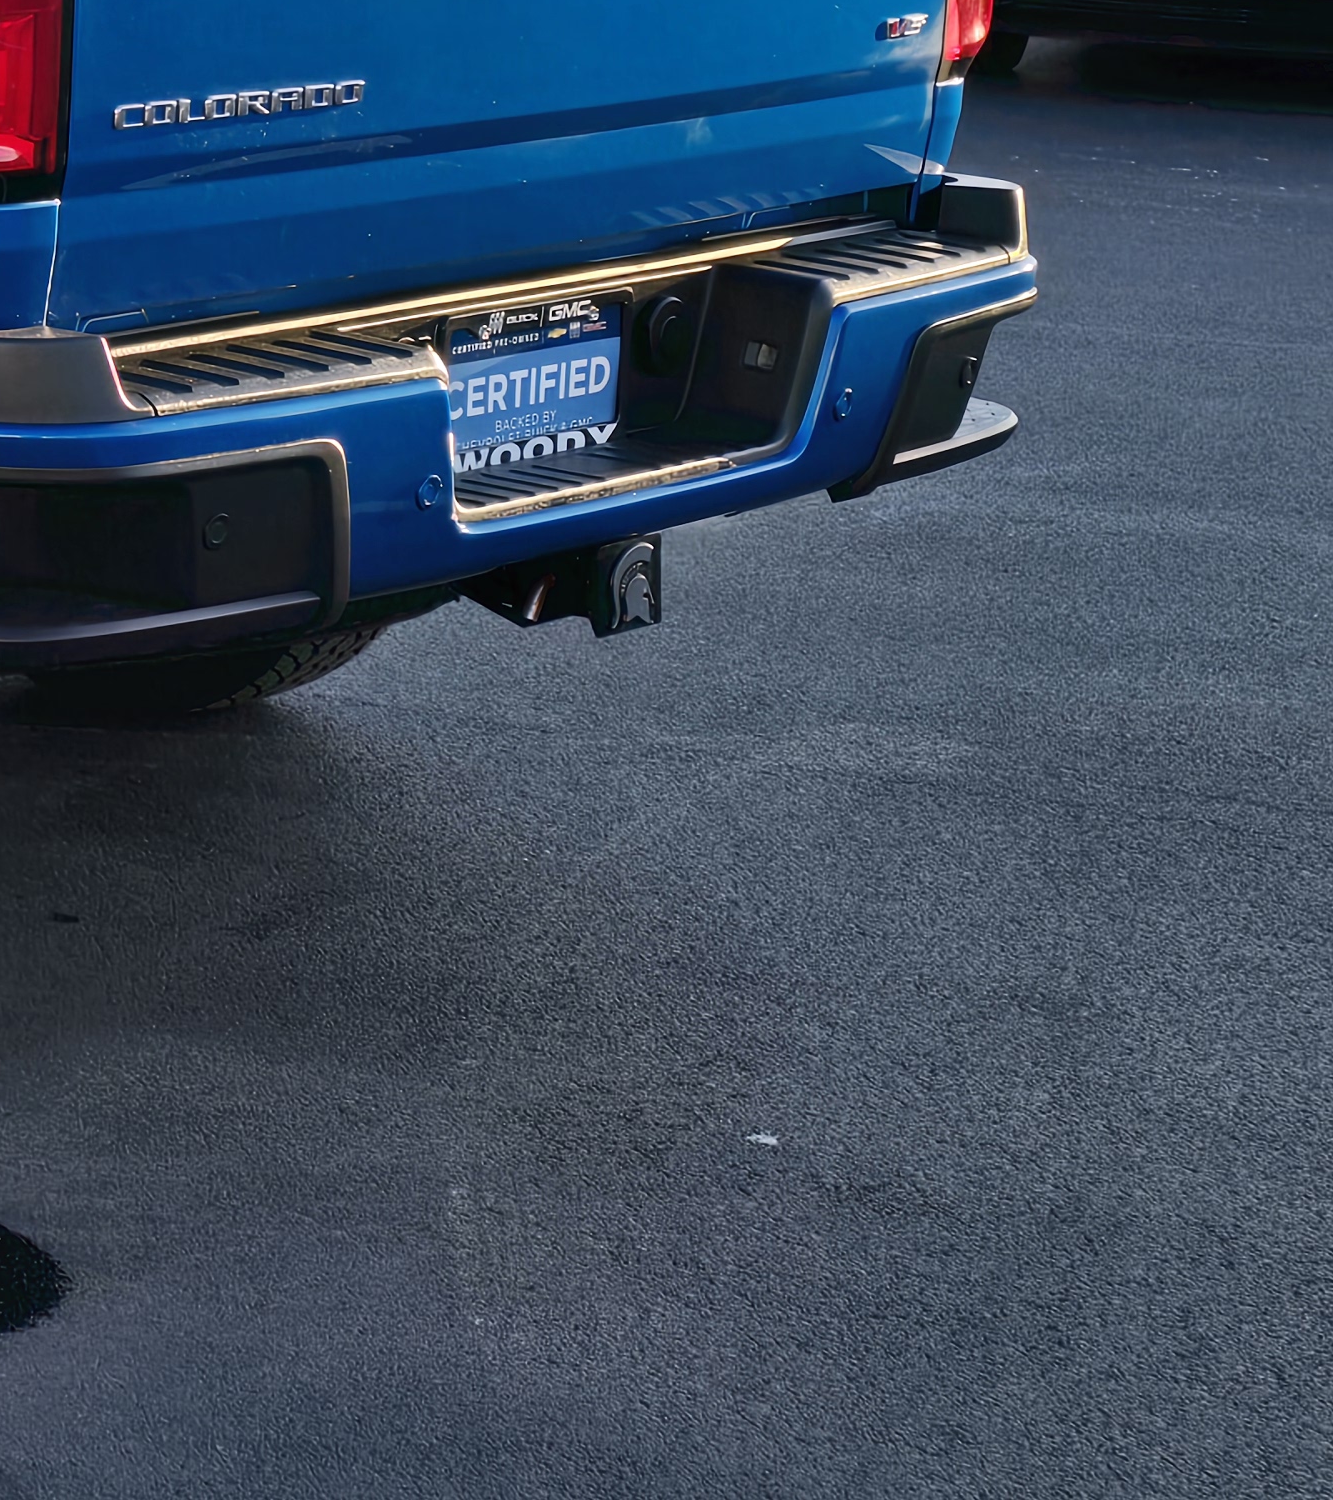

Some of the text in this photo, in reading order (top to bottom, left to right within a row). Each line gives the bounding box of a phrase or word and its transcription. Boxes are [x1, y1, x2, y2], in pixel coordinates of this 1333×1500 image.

[114, 79, 366, 130] COLORADO
[548, 299, 592, 322] GMC
[452, 340, 493, 355] CERTIFIED
[449, 356, 611, 420] CERTIFIED
[495, 409, 557, 432] BACKED BY
[454, 422, 618, 474] WOODY
